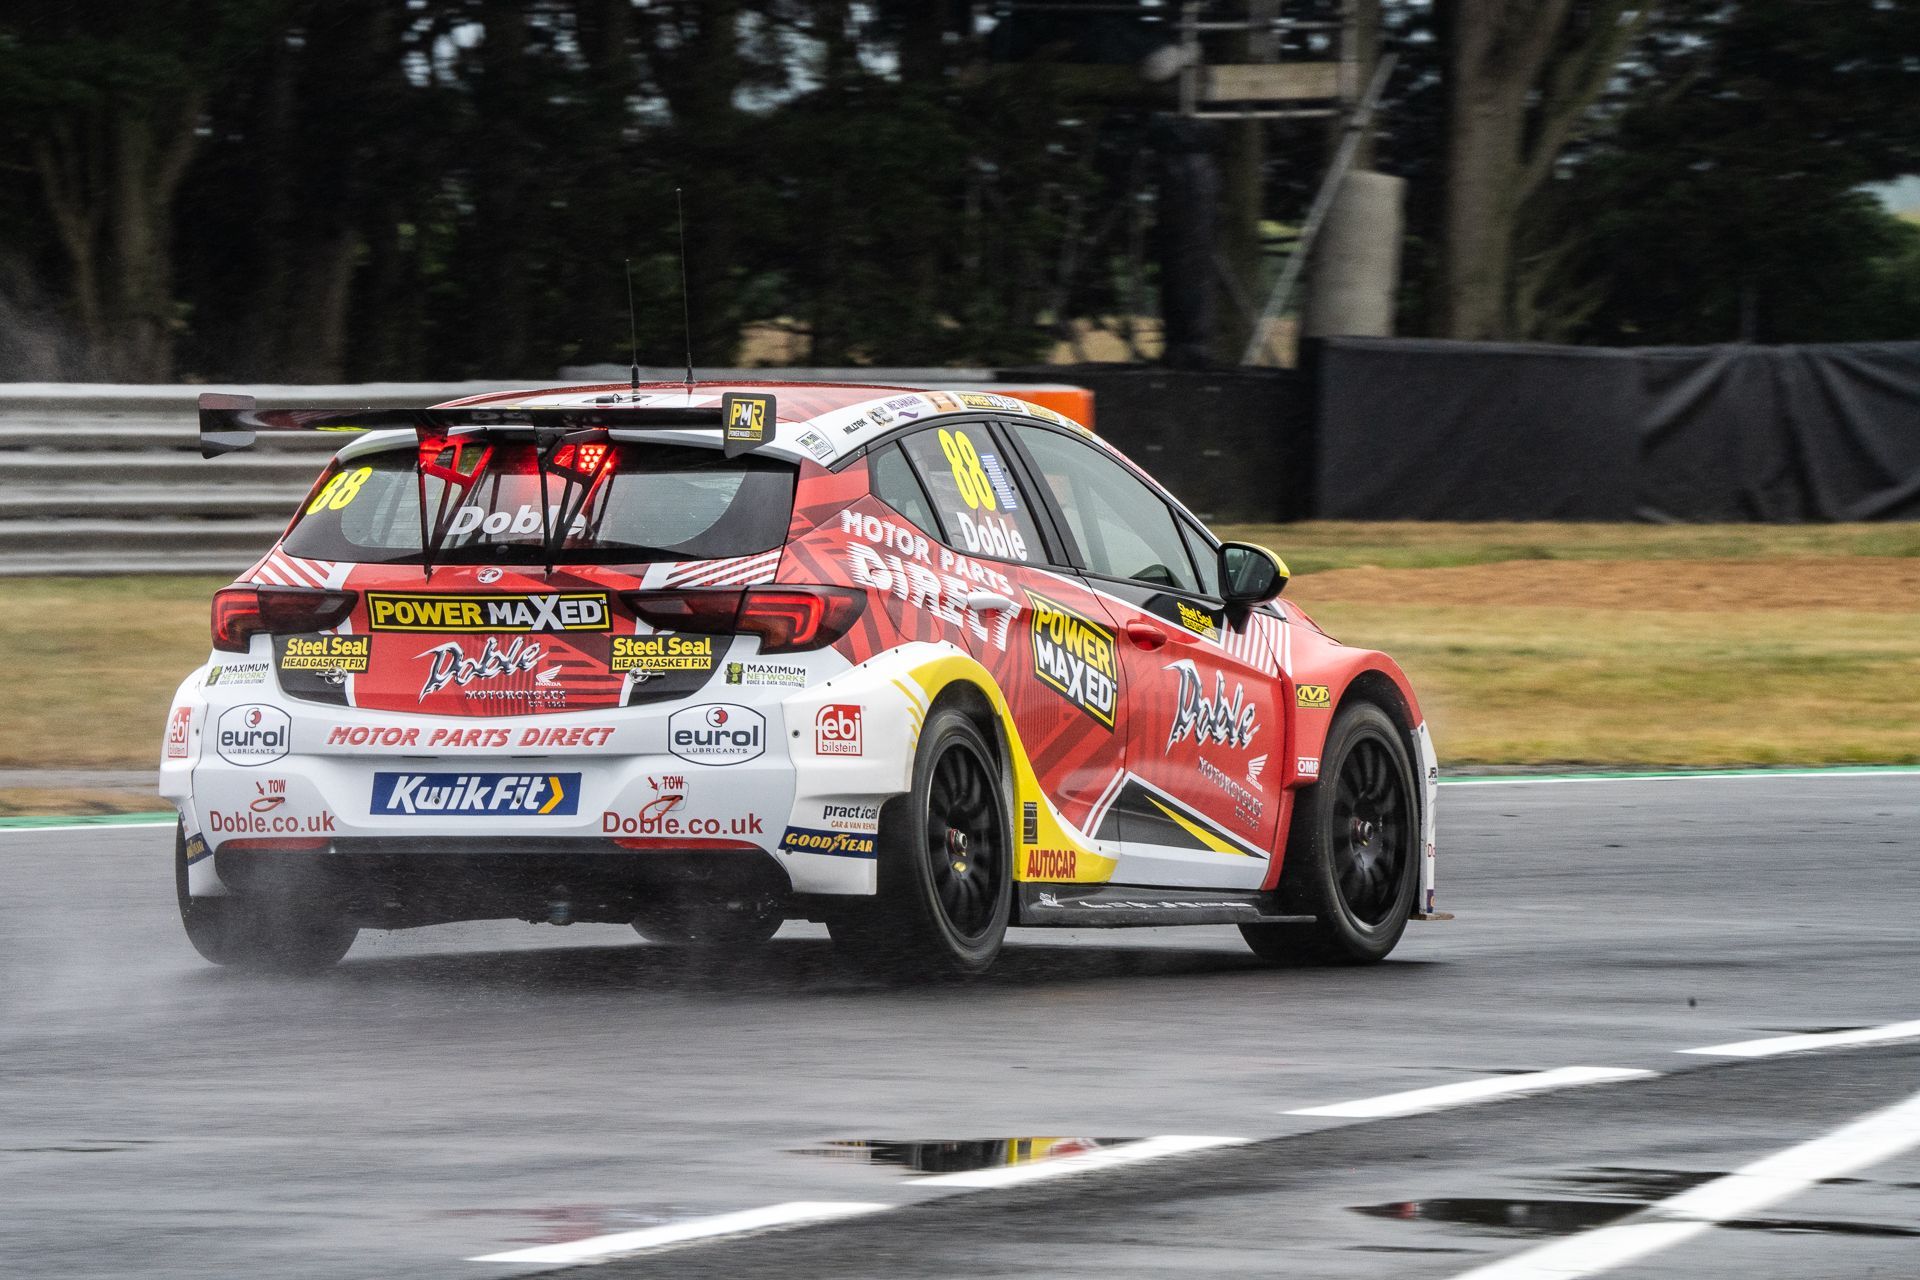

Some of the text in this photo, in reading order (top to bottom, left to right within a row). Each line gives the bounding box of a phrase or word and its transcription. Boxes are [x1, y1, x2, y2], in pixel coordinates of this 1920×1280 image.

[731, 402, 763, 426] PMR
[938, 428, 996, 512] 88
[306, 467, 373, 515] 88
[956, 511, 1028, 562] Doble
[840, 509, 1015, 596] MOTOR PARTS
[375, 594, 602, 631] POWER MAXED
[285, 637, 368, 657] Steel Seal
[612, 637, 712, 657] Steel Seal
[1035, 598, 1114, 677] POWER
[224, 663, 270, 674] MAXIMUM
[283, 657, 366, 669] HEAD GASKET FIX
[411, 636, 550, 705] Doble
[613, 657, 709, 669] HEAD GASKET FIX
[746, 664, 807, 676] MAXIMUM
[1035, 632, 1115, 713] MAXED
[746, 673, 806, 683] NETWORKS
[464, 689, 566, 700] MOTORCYCLES
[1161, 658, 1260, 757] Doble
[816, 705, 862, 741] febi
[221, 725, 285, 747] eurol
[327, 726, 616, 748] MOTOR PARTS DIRECT
[674, 725, 759, 747] eurol
[821, 741, 857, 753] bilstein
[686, 747, 748, 755] LUBRICANTS
[1297, 760, 1319, 774] OMP
[268, 779, 286, 793] TOW
[662, 775, 684, 790] TOW
[209, 810, 336, 833] Doble.co.uk
[602, 811, 764, 835] Doble.co.uk
[823, 804, 880, 820] practical
[785, 833, 874, 853] GOODYEAR
[1026, 849, 1077, 879] AUTOCAR
